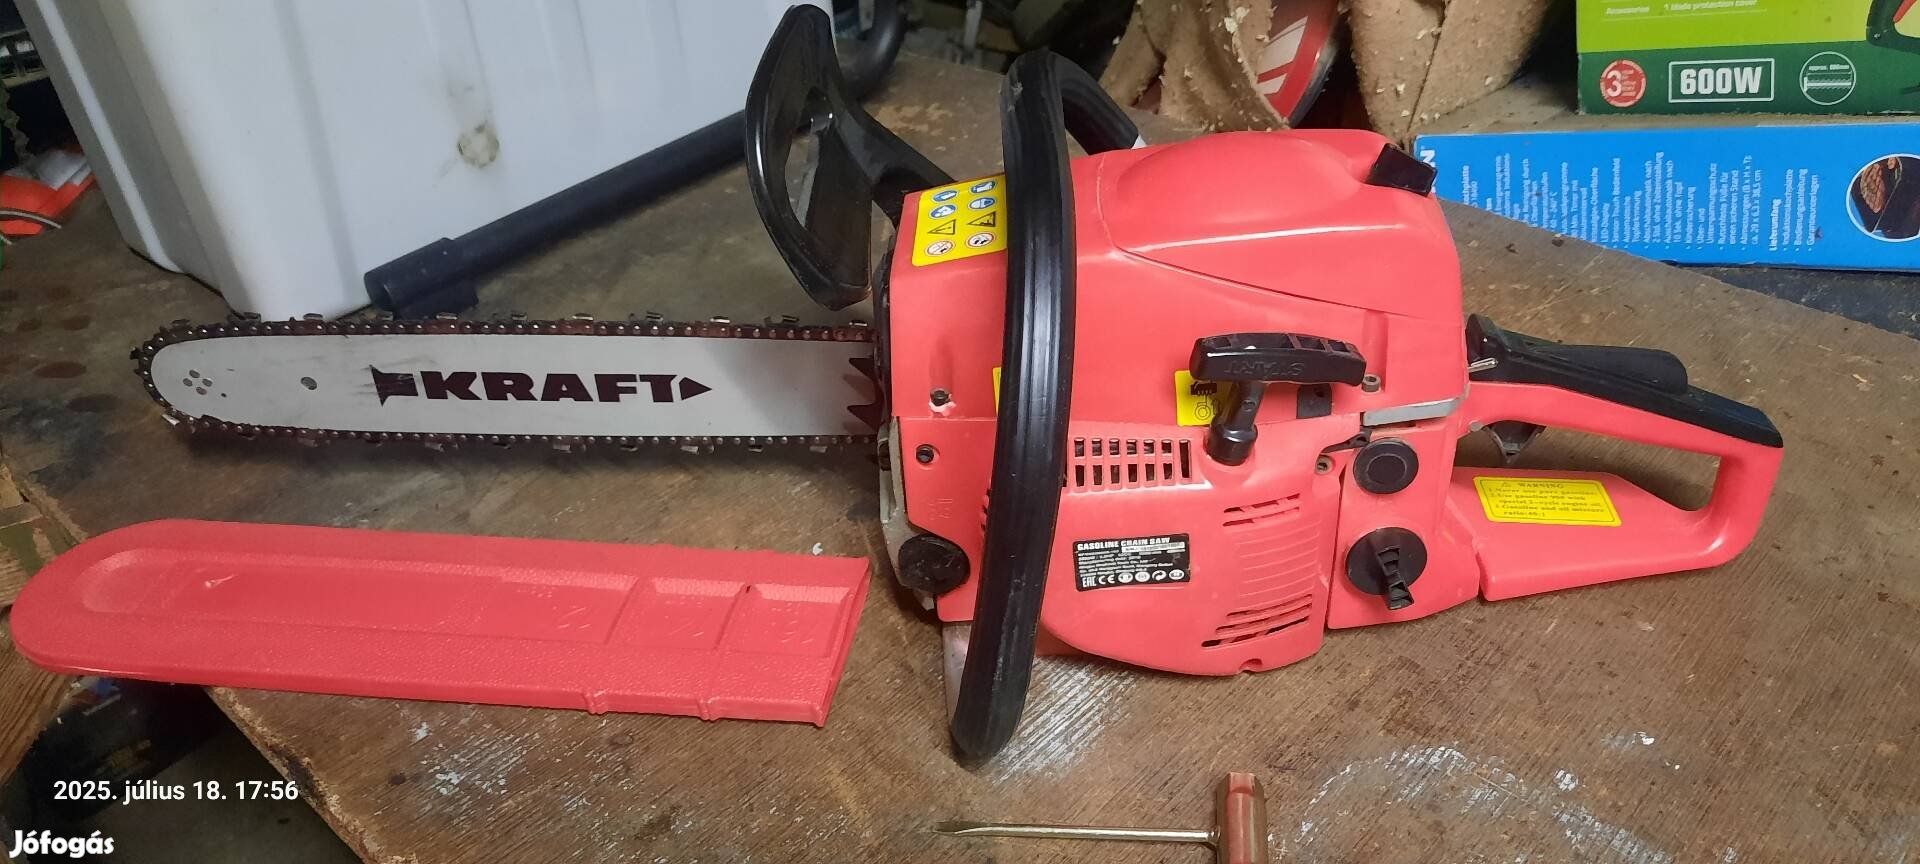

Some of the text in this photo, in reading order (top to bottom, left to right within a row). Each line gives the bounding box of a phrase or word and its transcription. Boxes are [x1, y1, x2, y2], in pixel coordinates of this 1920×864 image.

[1607, 70, 1621, 97] 3
[1680, 66, 1762, 95] 600W
[1769, 198, 1781, 251] Lieferumfang
[1225, 360, 1305, 376] START
[420, 371, 678, 403] KRAFT
[1077, 541, 1119, 551] GASOLINE
[1120, 538, 1148, 547] CHAIN
[1149, 537, 1171, 545] SAW
